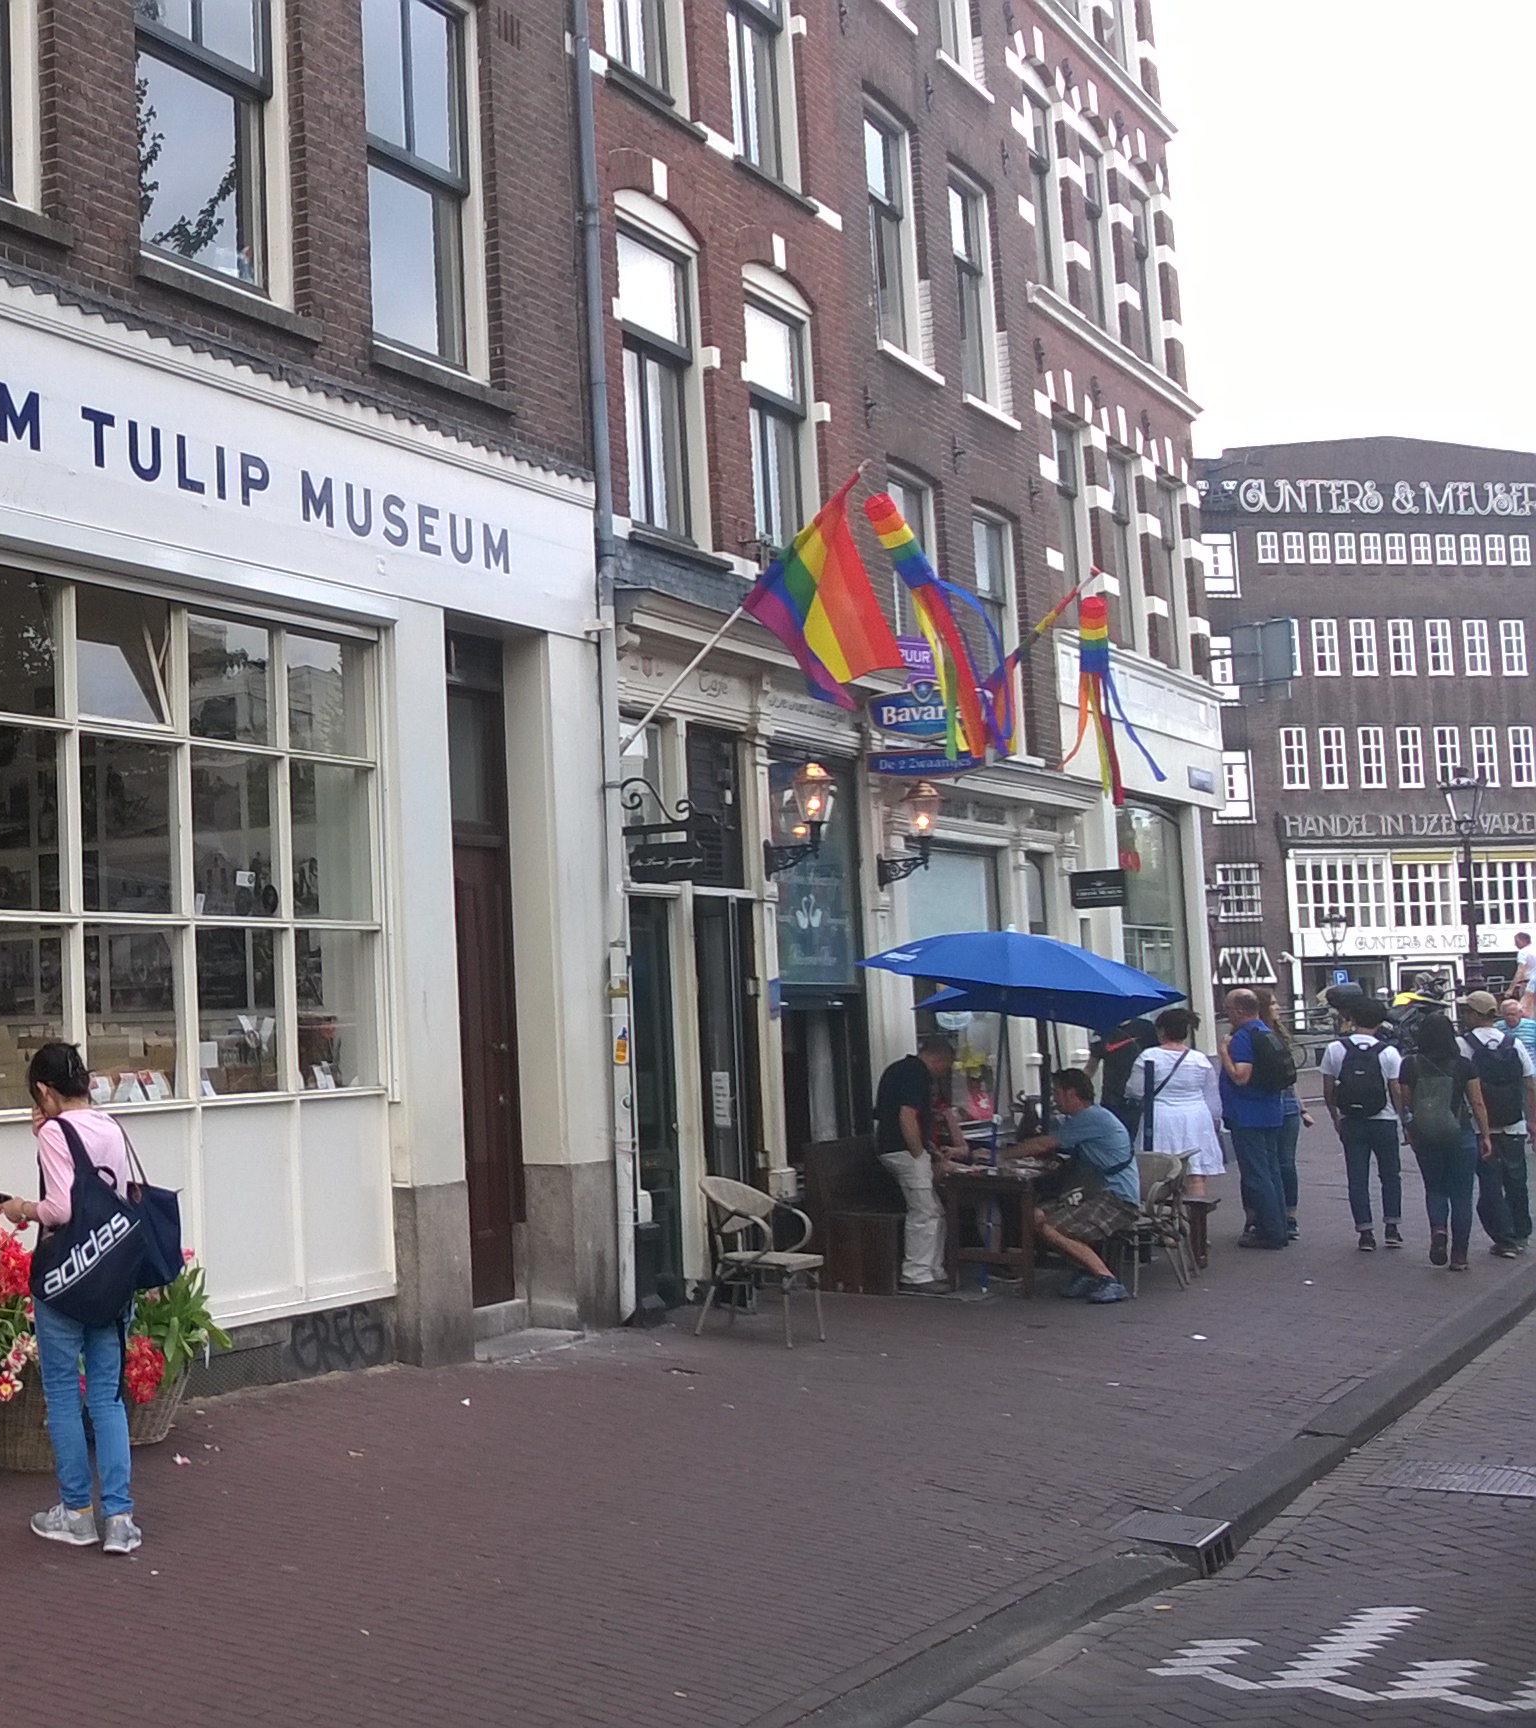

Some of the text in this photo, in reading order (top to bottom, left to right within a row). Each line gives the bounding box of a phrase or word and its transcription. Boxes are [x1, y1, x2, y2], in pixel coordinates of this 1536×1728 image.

[80, 405, 271, 508] TULIP
[300, 469, 512, 575] MUSEUM
[1391, 480, 1419, 515] &
[1283, 815, 1377, 838] HANDEL
[1380, 814, 1405, 837] IN
[43, 1210, 131, 1296] adidas
